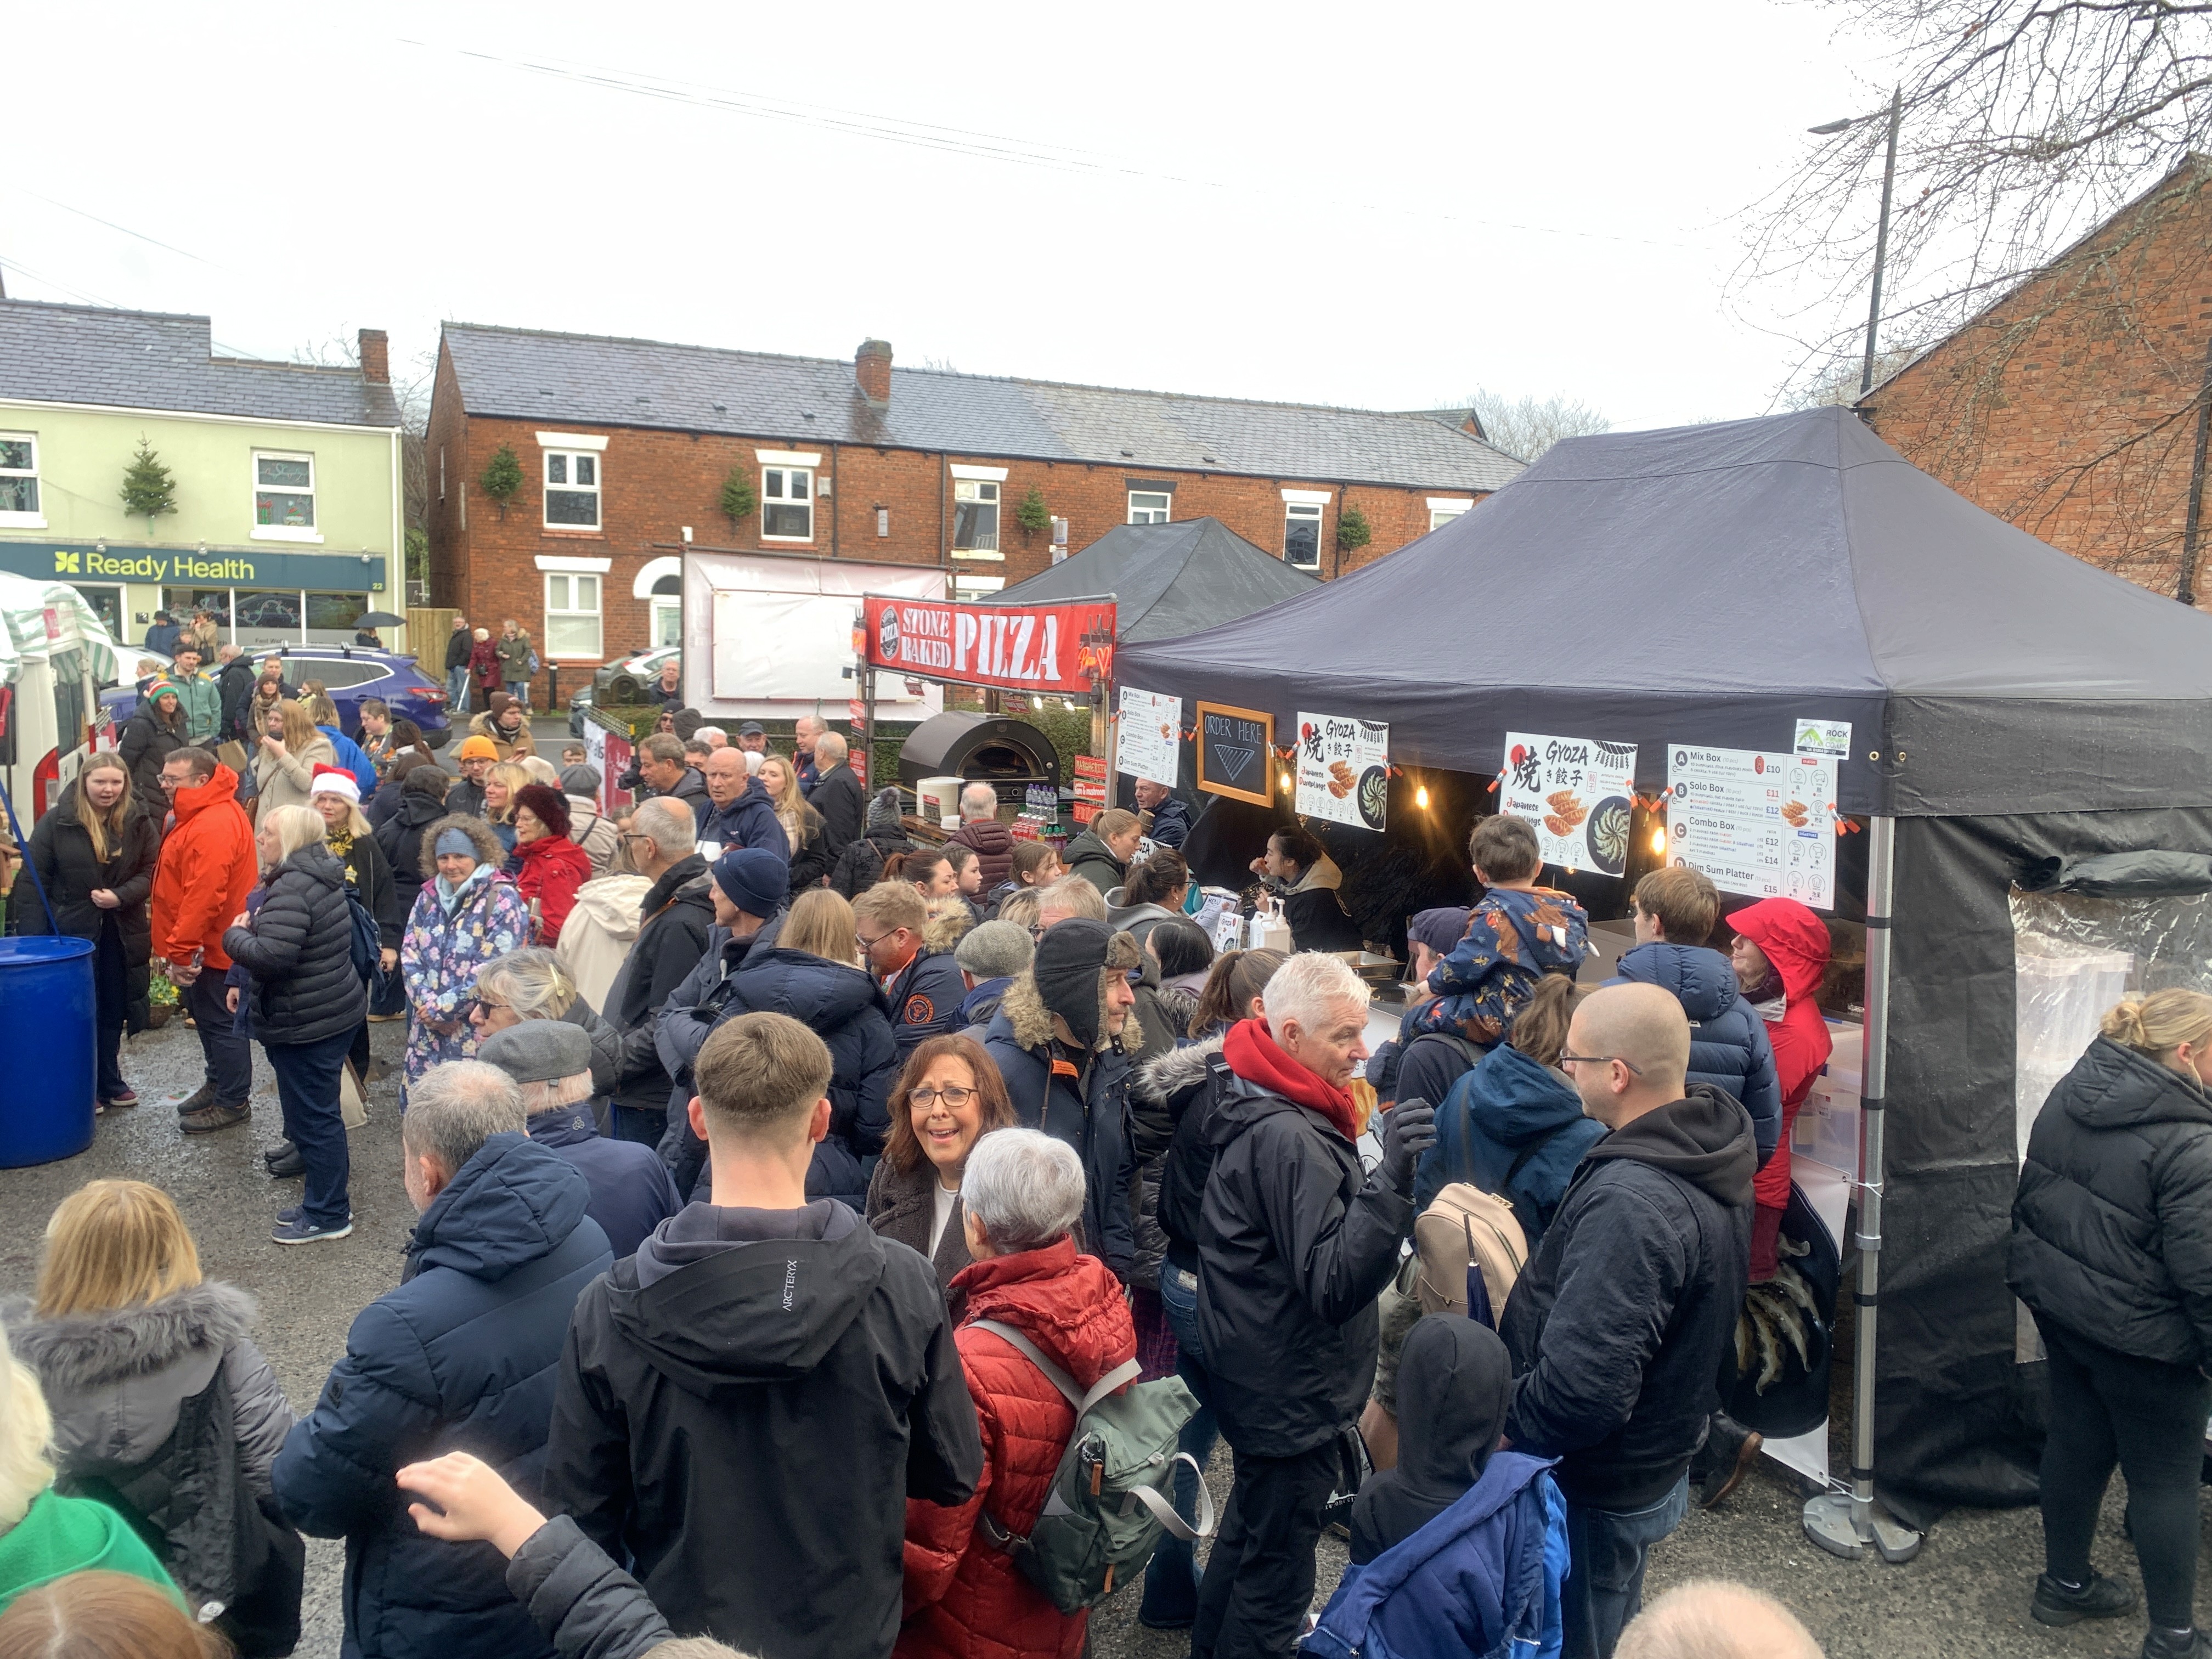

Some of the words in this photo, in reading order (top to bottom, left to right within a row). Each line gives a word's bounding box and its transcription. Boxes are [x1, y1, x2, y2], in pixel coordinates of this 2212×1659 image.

[86, 552, 167, 582] Ready
[174, 555, 255, 579] Health
[902, 607, 951, 638] STONE
[901, 635, 952, 669] BAKED
[953, 612, 1062, 681] PIZZA
[1205, 715, 1232, 738] ORDER
[1238, 720, 1262, 744] HERE
[1326, 719, 1356, 741] GYOZA
[1826, 729, 1849, 738] ROCK
[1546, 740, 1589, 766] GYOZA
[1690, 752, 1704, 761] Mix
[1706, 753, 1721, 762] Box
[1301, 766, 1324, 778] Japanese
[1547, 767, 1583, 787] き餃子
[1766, 765, 1780, 774] £10
[1299, 776, 1326, 792] Dumplings
[1679, 786, 1684, 795] B
[1690, 781, 1707, 791] Solo
[1709, 783, 1724, 793] Box
[1767, 789, 1780, 798] £11
[1506, 797, 1539, 811] Japanese
[1766, 806, 1779, 815] £12
[1678, 826, 1684, 835] C
[1689, 817, 1718, 828] Combo
[1720, 821, 1735, 830] Box
[1765, 838, 1779, 847] £12
[1765, 856, 1778, 865] £14
[1689, 862, 1704, 871] Dim
[1706, 865, 1724, 875] Sum
[1726, 868, 1754, 880] Platter
[1764, 884, 1778, 894] £15
[782, 1260, 797, 1312] ARC'TERYX
